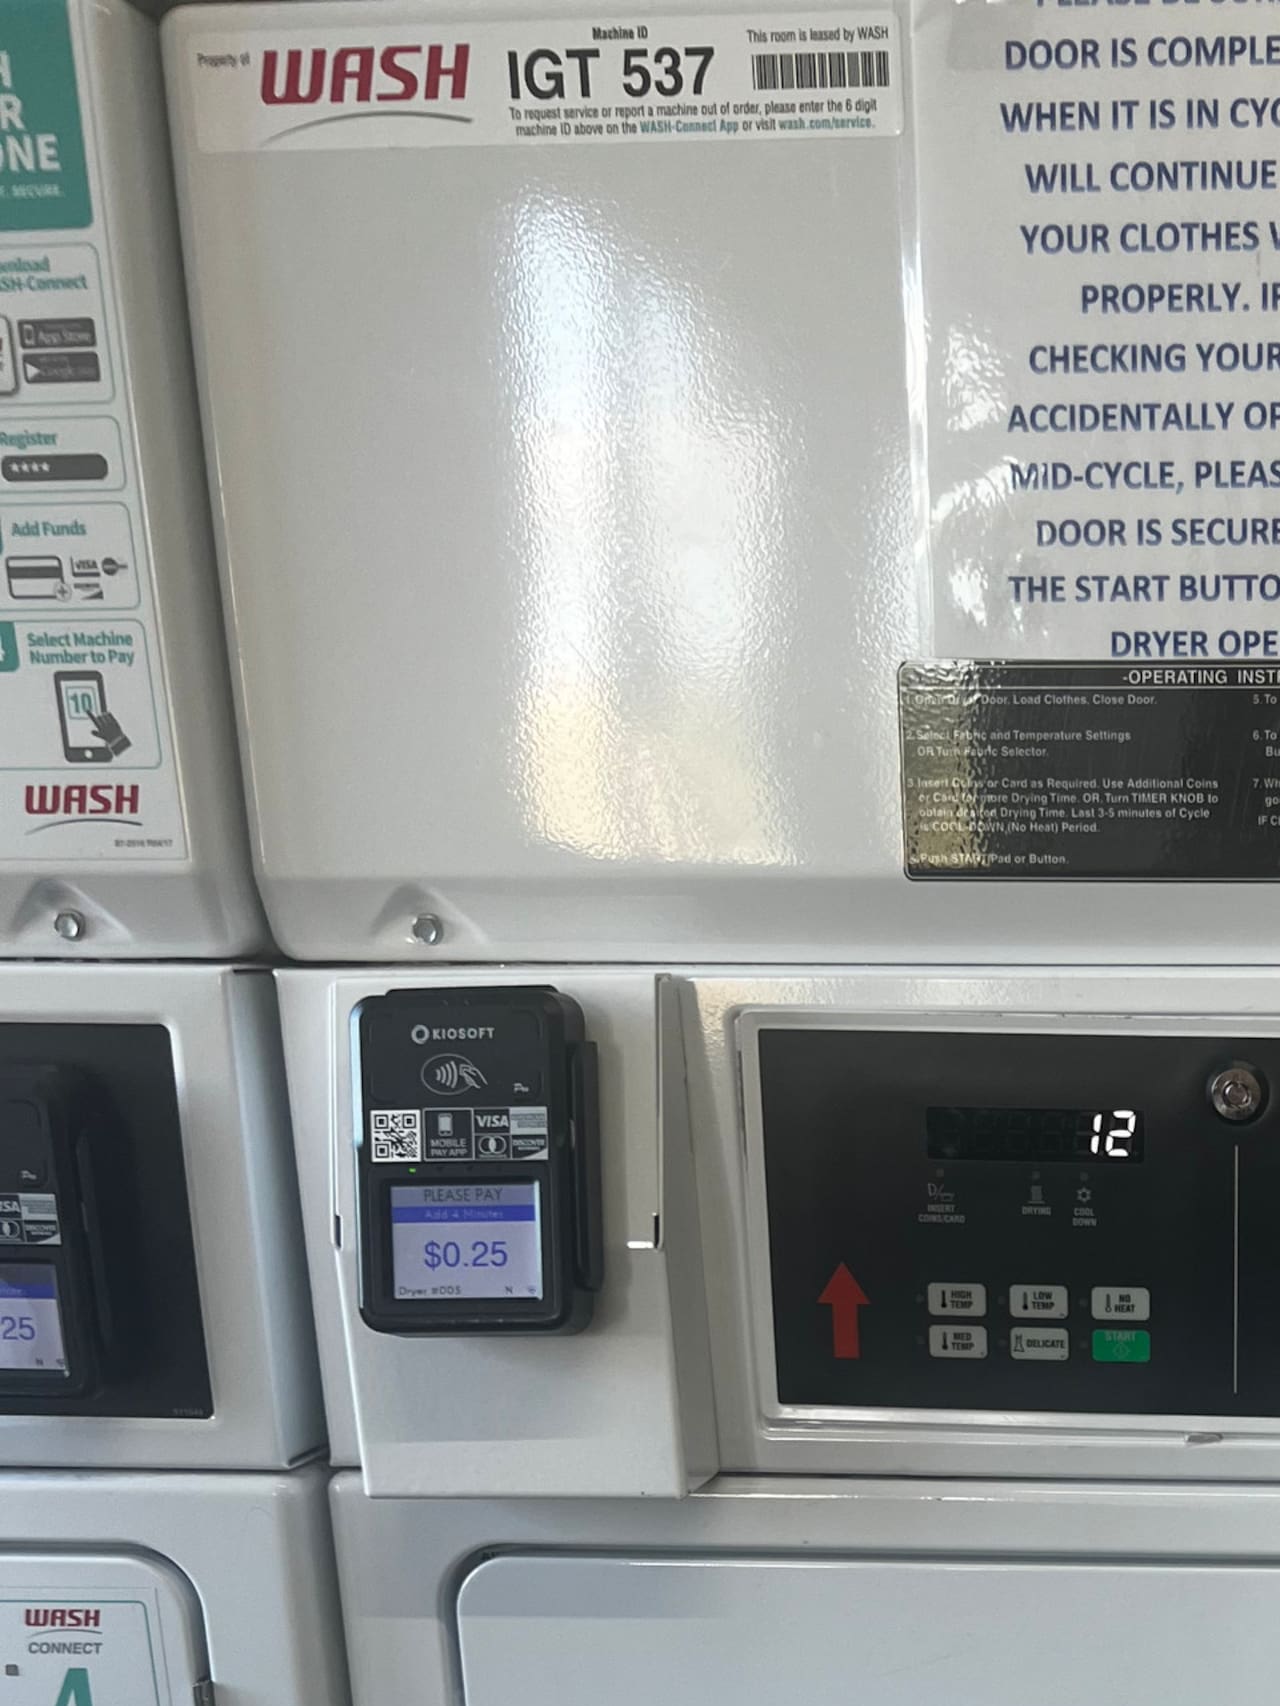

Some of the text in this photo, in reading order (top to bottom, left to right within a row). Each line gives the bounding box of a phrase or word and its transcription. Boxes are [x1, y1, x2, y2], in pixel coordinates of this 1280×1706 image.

[592, 26, 648, 40] Machine ID
[747, 27, 888, 43] This room is leased by WASH
[1006, 39, 1100, 70] DOOR
[1112, 38, 1137, 67] IS
[261, 43, 470, 105] WASH
[508, 47, 714, 100] IGT 537
[509, 100, 877, 121] To request service or report a machine out of order, please enter the 6 digit
[1000, 101, 1099, 131] WHEN
[1112, 100, 1139, 129] IT
[1150, 99, 1175, 129] IS
[1187, 99, 1218, 128] IN
[516, 116, 875, 136] machine ID above on the WASH-Connect App or visit wash.com/service.
[1025, 163, 1100, 192] WILL
[1110, 160, 1276, 191] CONTINUE
[1020, 224, 1109, 253] YOUR
[1120, 221, 1259, 252] CLOTHES
[1082, 283, 1249, 313] PROPERLY.
[1029, 344, 1185, 373] CHECKING
[1008, 402, 1234, 432] ACCIDENTALLY
[1010, 461, 1184, 494] MID-CYCLE,
[11, 520, 87, 537] Add Funds
[1037, 519, 1126, 546] DOOR
[1138, 519, 1162, 545] IS
[1008, 576, 1065, 602] THE
[1076, 575, 1170, 601] START
[27, 632, 133, 647] Select Machine
[1112, 631, 1208, 656] DRYER
[30, 650, 135, 667] Number to Pay
[1123, 669, 1227, 685] -OPERATING
[1253, 694, 1262, 704] 5.
[1264, 694, 1277, 704] To
[25, 785, 139, 814] WASH
[433, 1028, 495, 1040] KIOSOFT
[476, 1115, 509, 1128] VISA
[1090, 1110, 1136, 1157] 12
[424, 1189, 503, 1202] PLEASE PAY
[424, 1241, 508, 1269] $0.25
[25, 1609, 100, 1626] WASH
[28, 1643, 103, 1654] CONNECT
